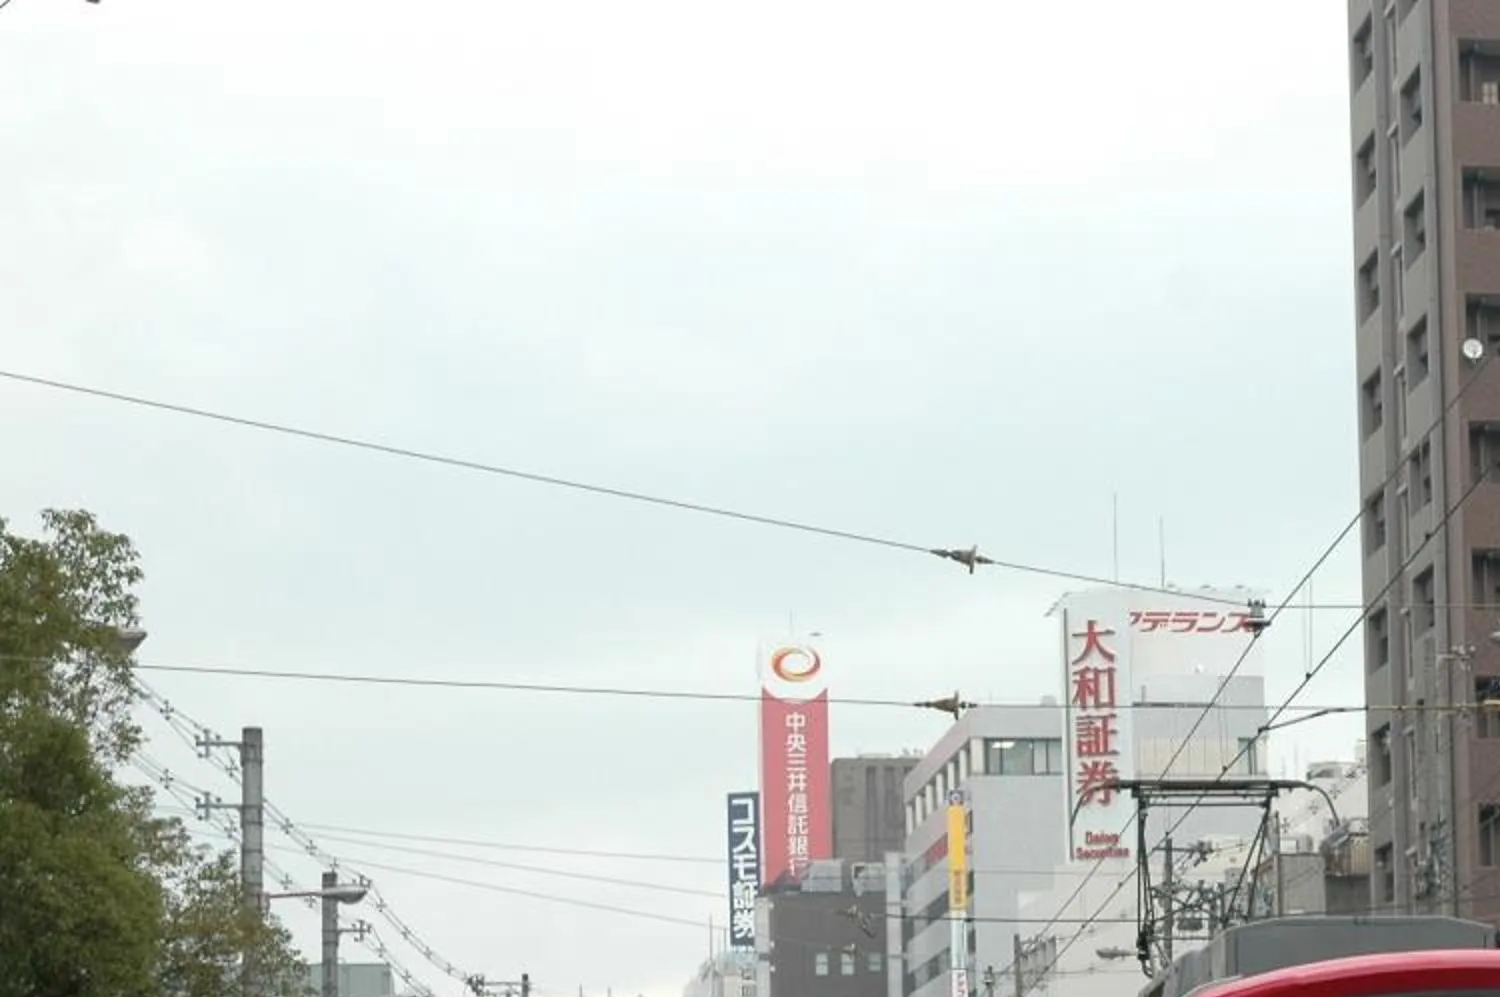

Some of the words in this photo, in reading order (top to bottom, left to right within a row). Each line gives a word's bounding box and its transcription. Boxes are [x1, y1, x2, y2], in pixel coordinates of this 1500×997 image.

[785, 711, 808, 877] 中央三井信託銀行
[1072, 619, 1120, 807] 大和証券
[731, 798, 758, 938] コスモ証券
